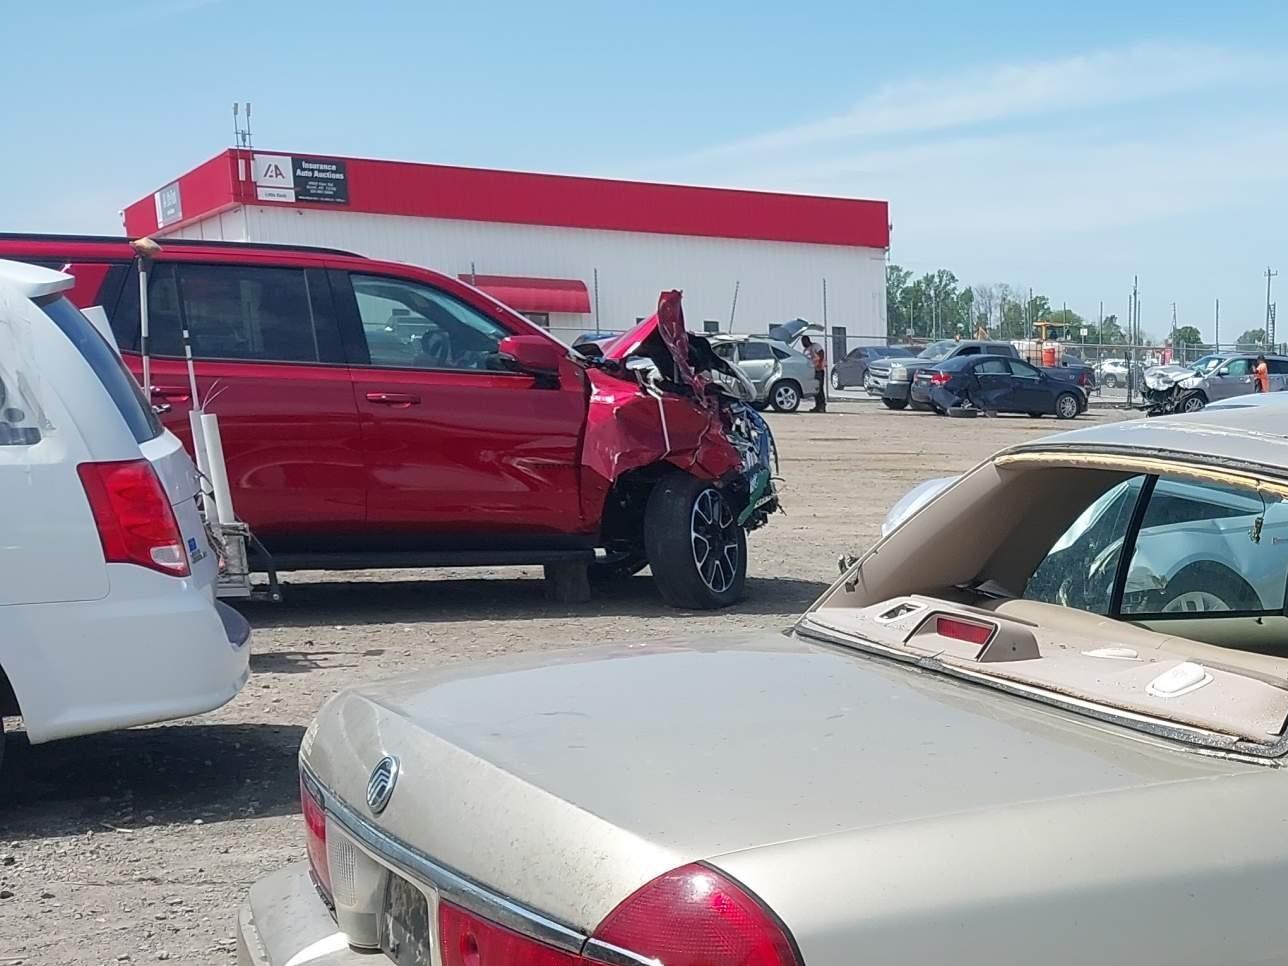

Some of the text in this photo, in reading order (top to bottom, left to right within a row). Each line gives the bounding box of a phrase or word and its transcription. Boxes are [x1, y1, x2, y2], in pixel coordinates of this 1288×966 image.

[302, 160, 337, 171] Insurance
[296, 168, 345, 180] Auto Auctions
